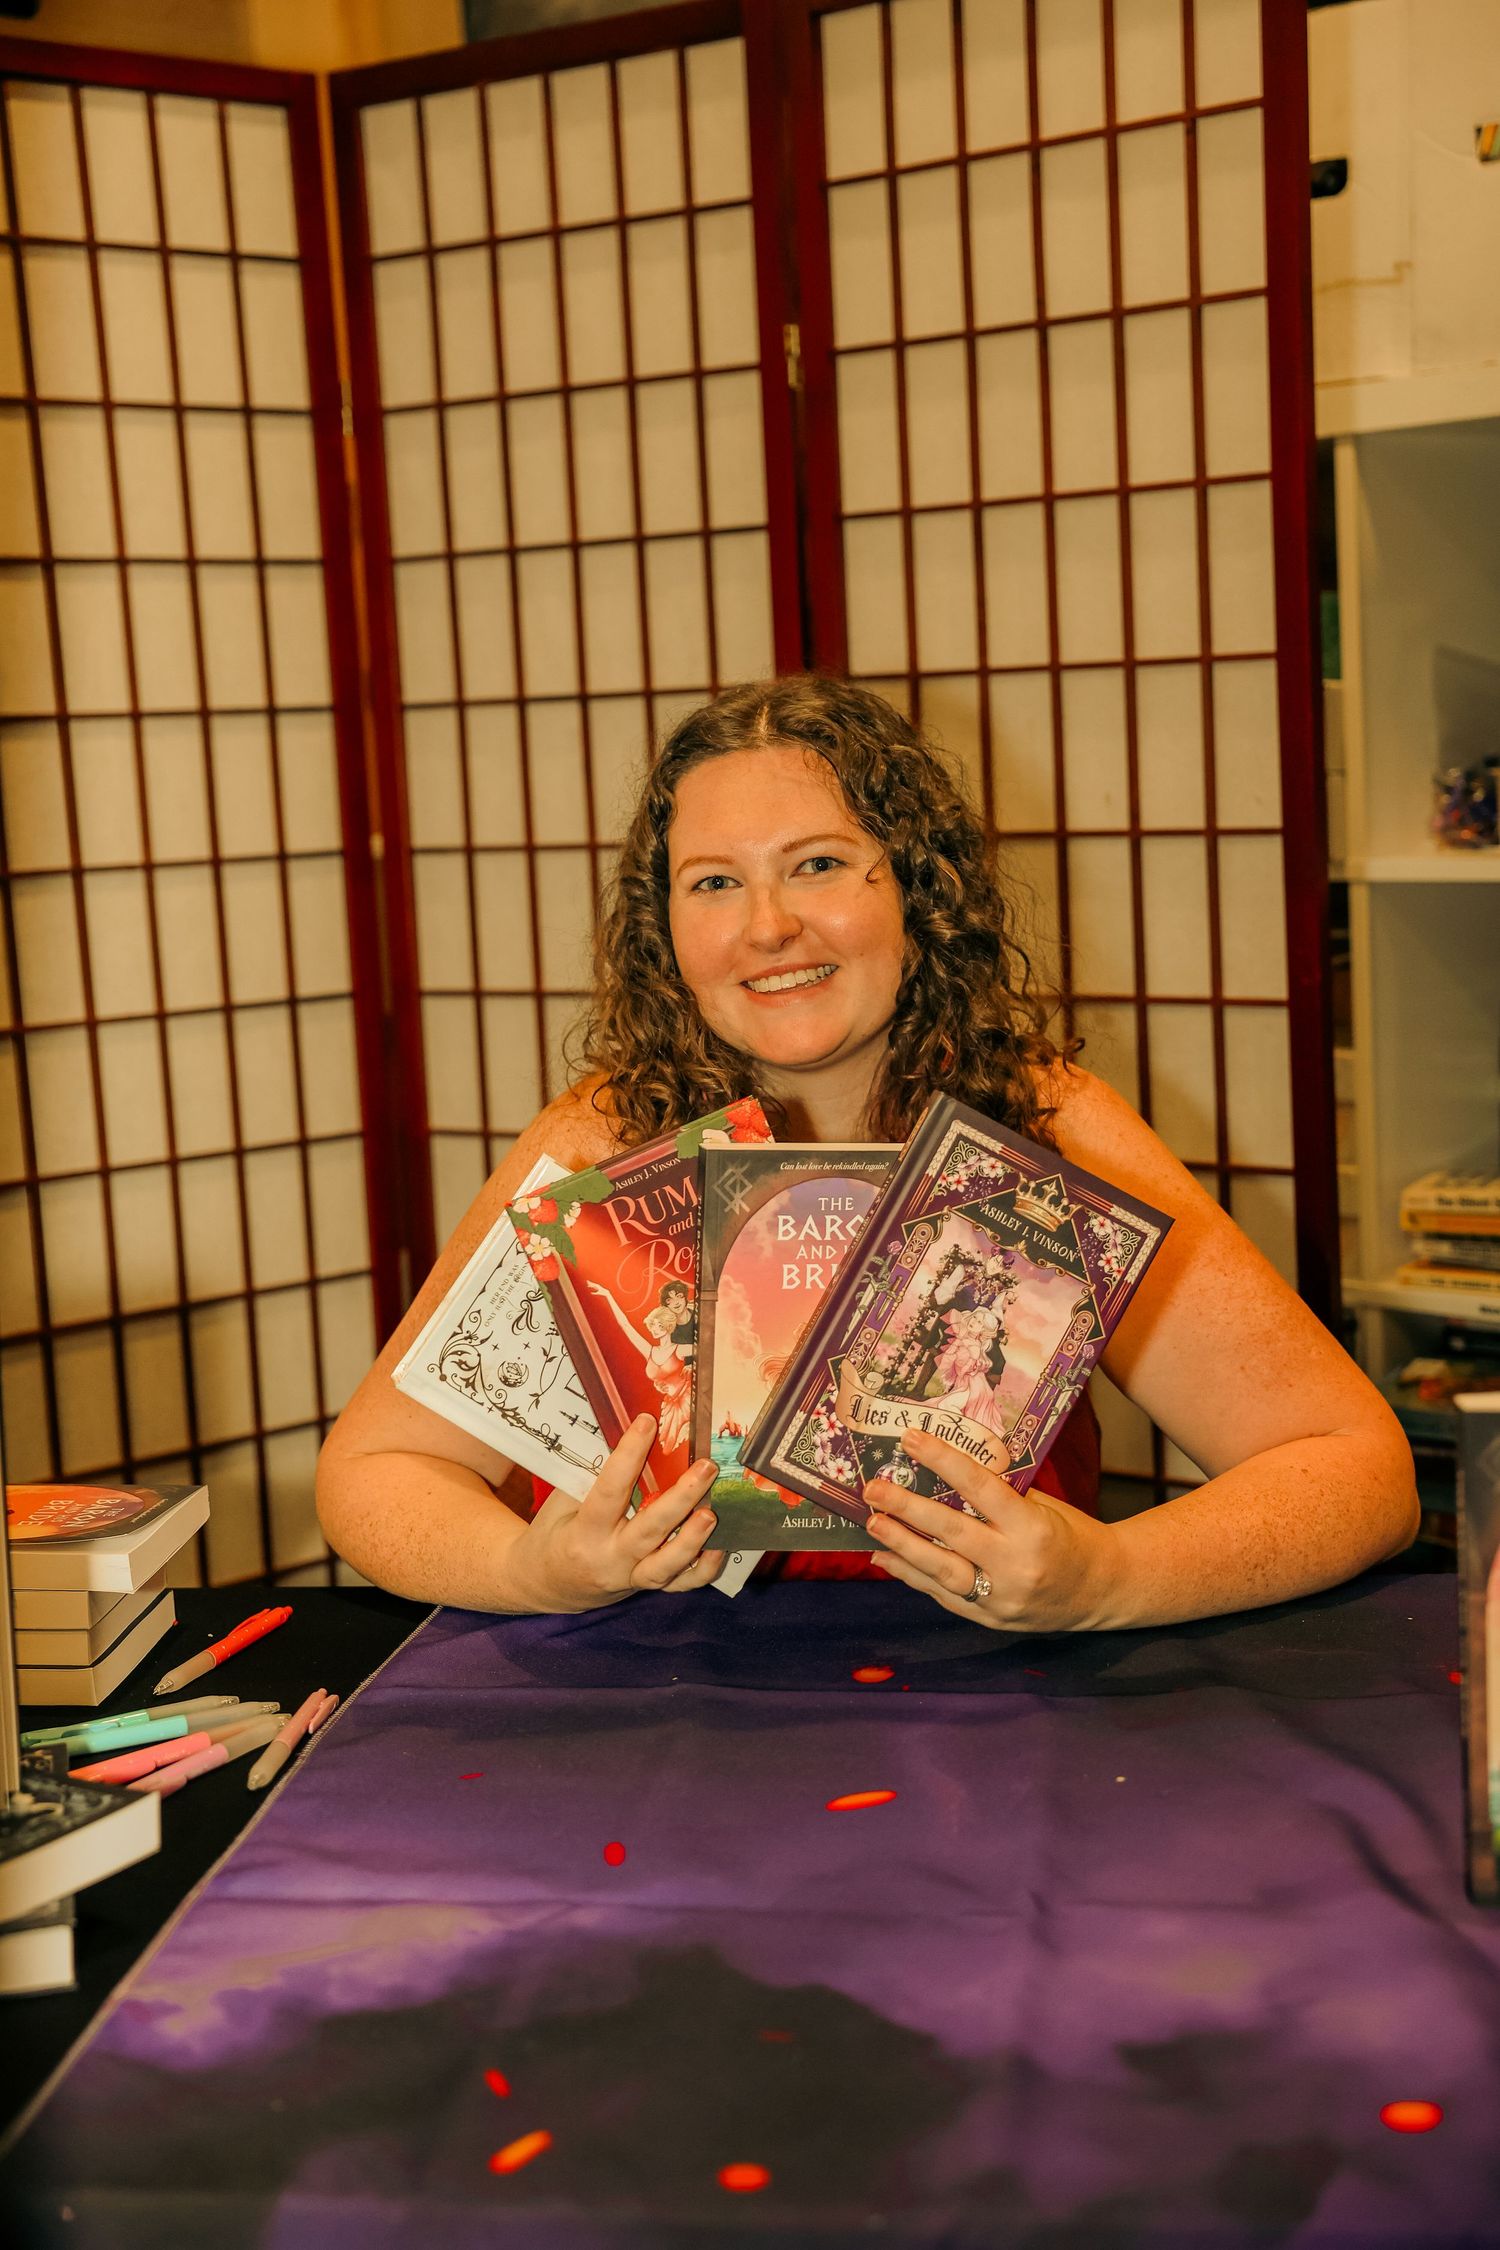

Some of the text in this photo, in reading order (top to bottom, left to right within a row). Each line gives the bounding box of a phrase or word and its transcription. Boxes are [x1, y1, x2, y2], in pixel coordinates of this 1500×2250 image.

[643, 1168, 652, 1180] J.
[780, 1162, 889, 1173] Can lost love be rekindled again?
[601, 1175, 699, 1247] RUM
[818, 1197, 854, 1211] THE
[668, 1211, 695, 1236] and
[980, 1203, 1022, 1231] ASHLEY
[1032, 1230, 1077, 1262] VINSON
[796, 1245, 837, 1260] AND
[846, 1394, 997, 1466] Lies & Lavender
[17, 1500, 76, 1526] BRIDE
[60, 1499, 122, 1527] BARON
[781, 1515, 825, 1528] ASHLEY
[825, 1514, 836, 1530] J.
